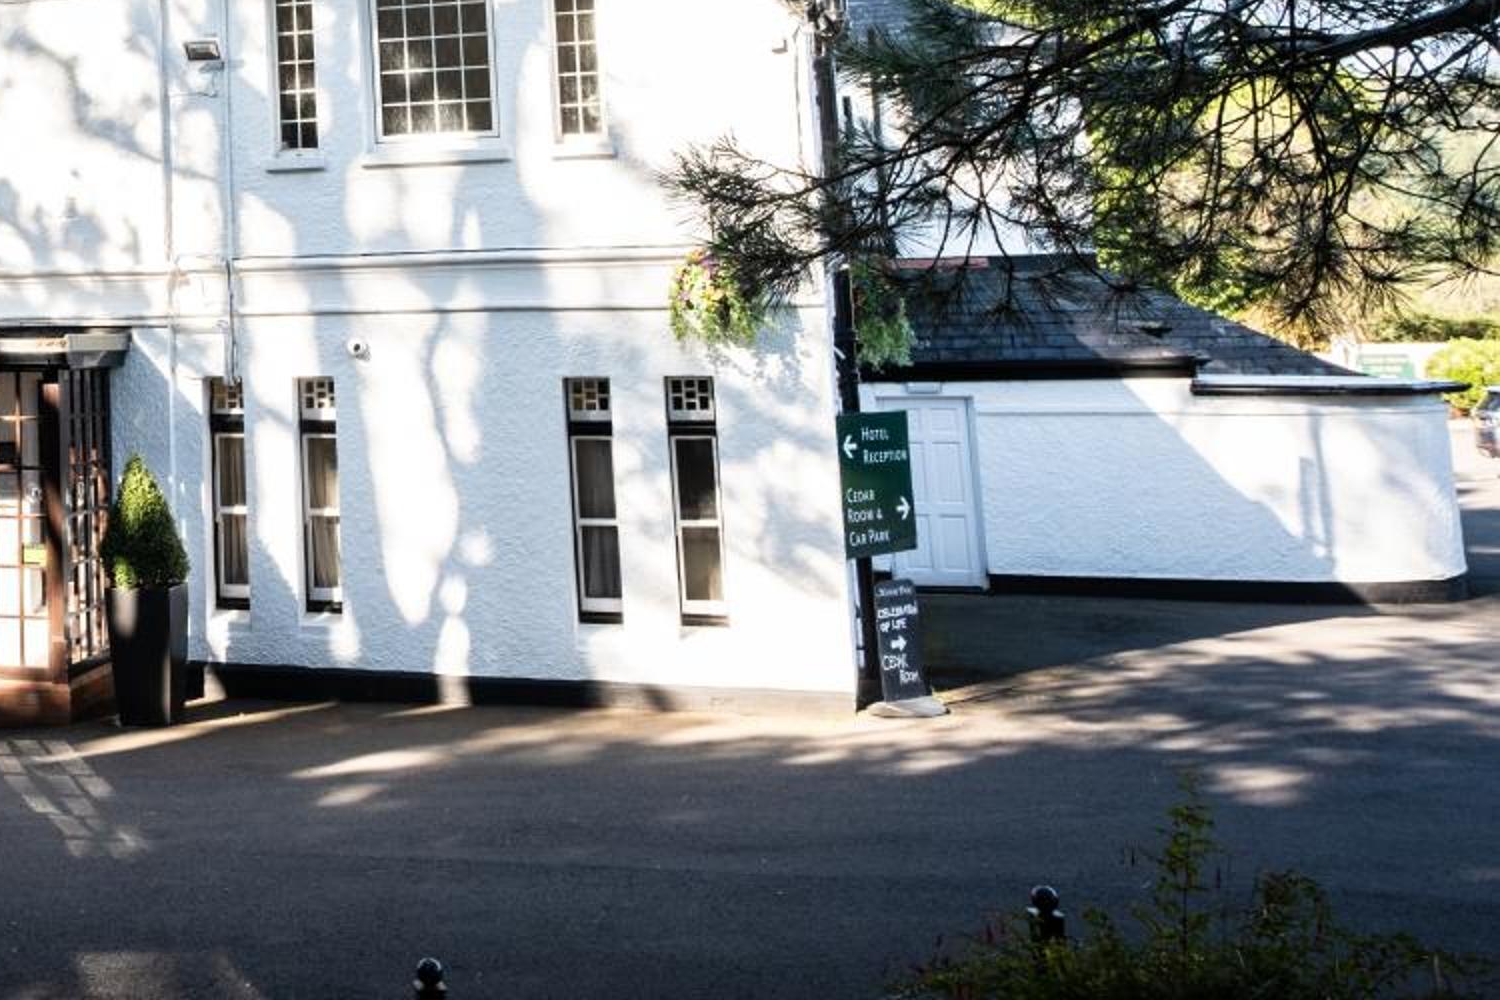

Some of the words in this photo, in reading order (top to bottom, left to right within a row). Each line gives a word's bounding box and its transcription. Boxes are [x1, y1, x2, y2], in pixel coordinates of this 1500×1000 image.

[861, 427, 889, 441] HOTEL
[863, 449, 907, 463] RECEPTION
[846, 488, 875, 503] CEDAR
[847, 509, 873, 522] ROOM
[876, 508, 883, 519] &
[849, 531, 867, 546] CAR
[869, 529, 890, 543] PARK
